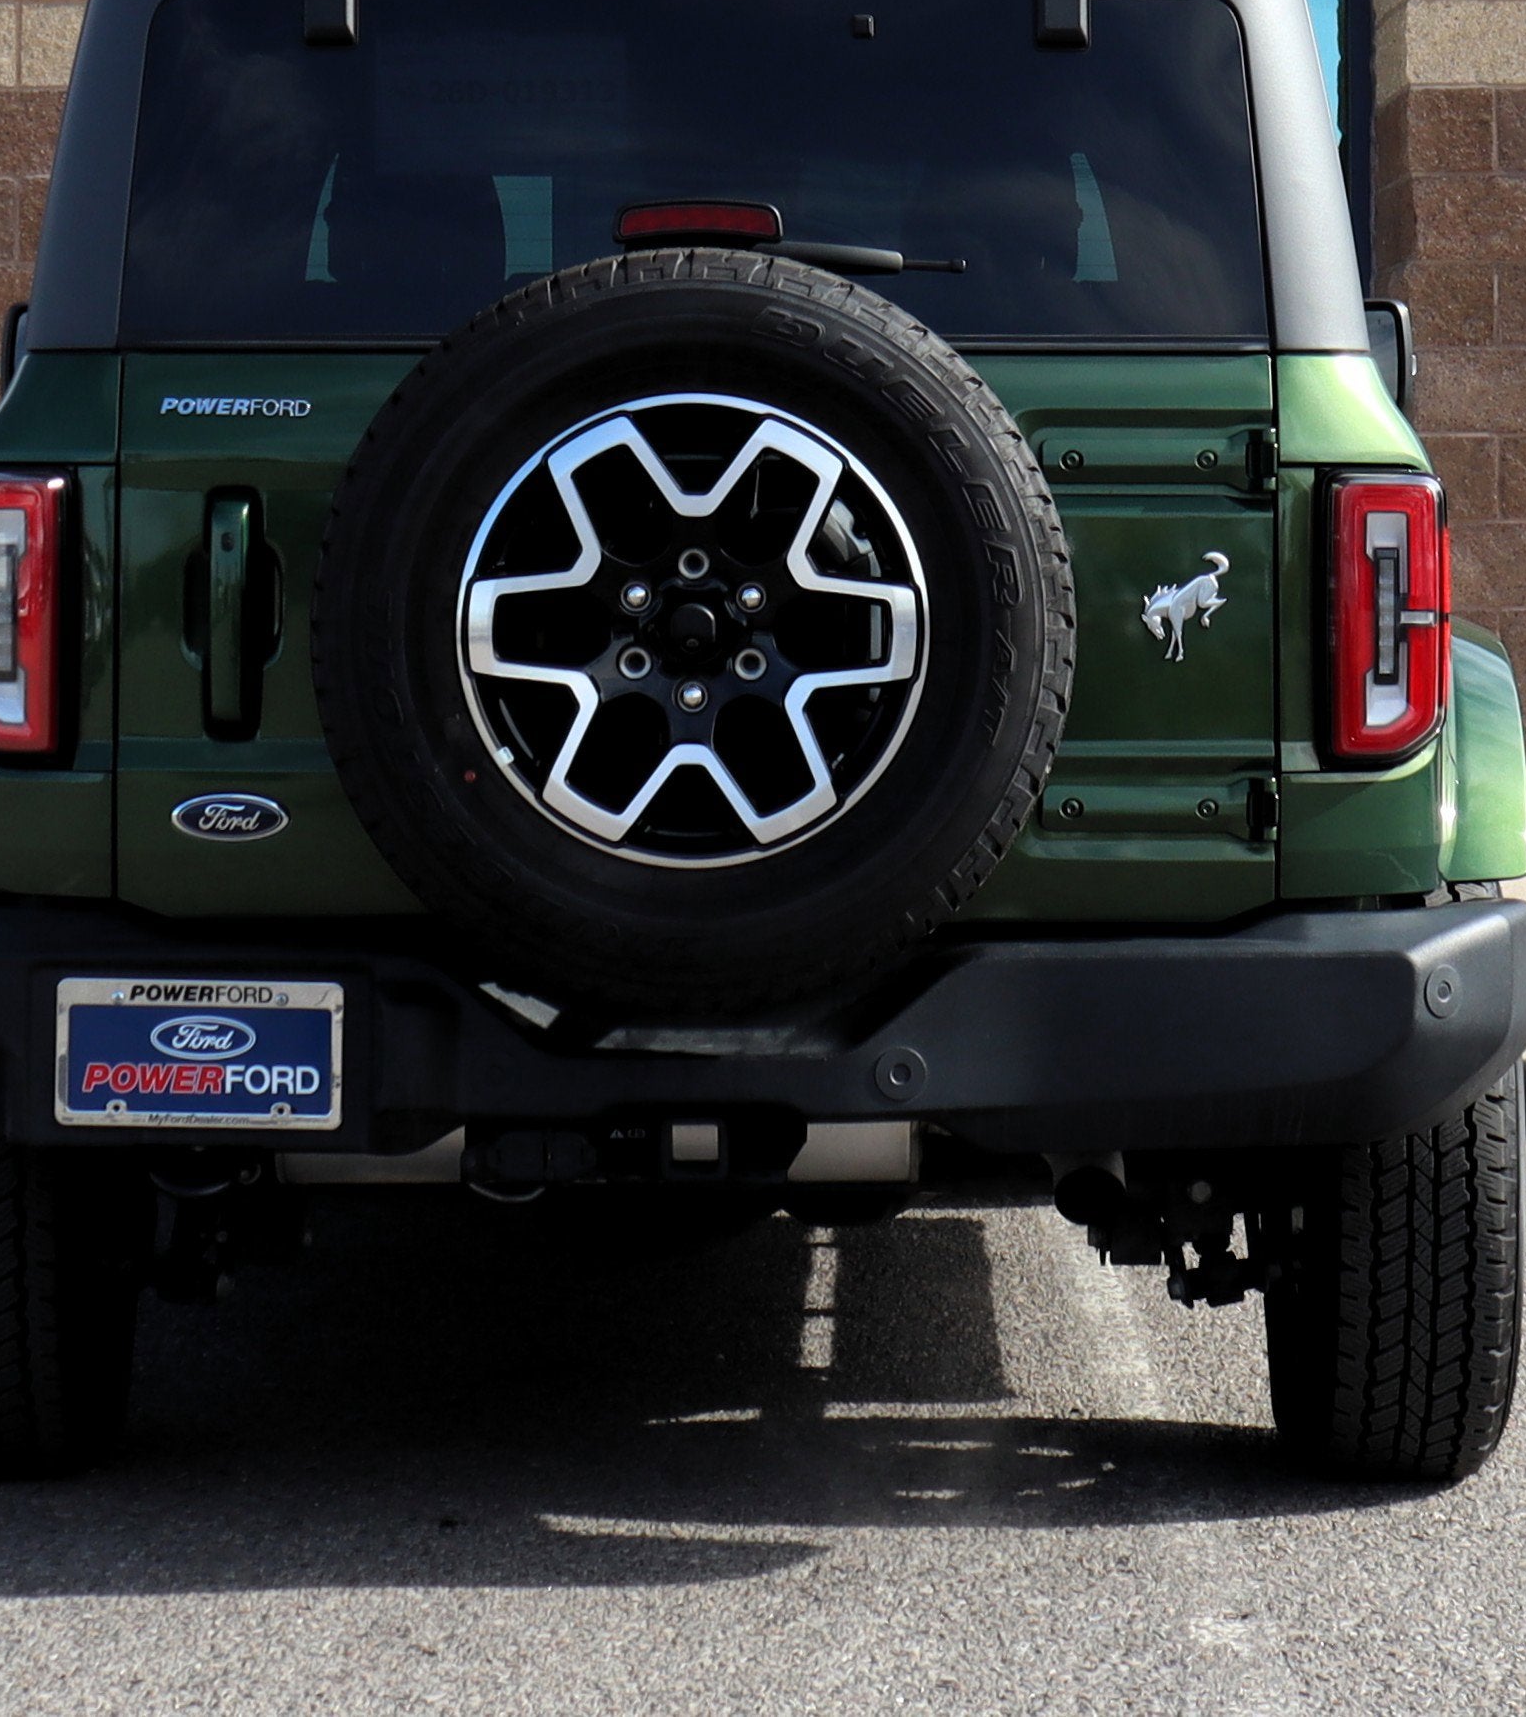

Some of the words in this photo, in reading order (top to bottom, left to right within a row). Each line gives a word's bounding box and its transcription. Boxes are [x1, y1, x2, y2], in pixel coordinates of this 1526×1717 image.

[160, 397, 312, 417] POWERFORD
[749, 305, 1026, 610] DUELER
[198, 803, 262, 831] Ford
[129, 984, 273, 1004] POWERFORD
[171, 1023, 235, 1050] Ford
[82, 1062, 320, 1095] POWERFORD
